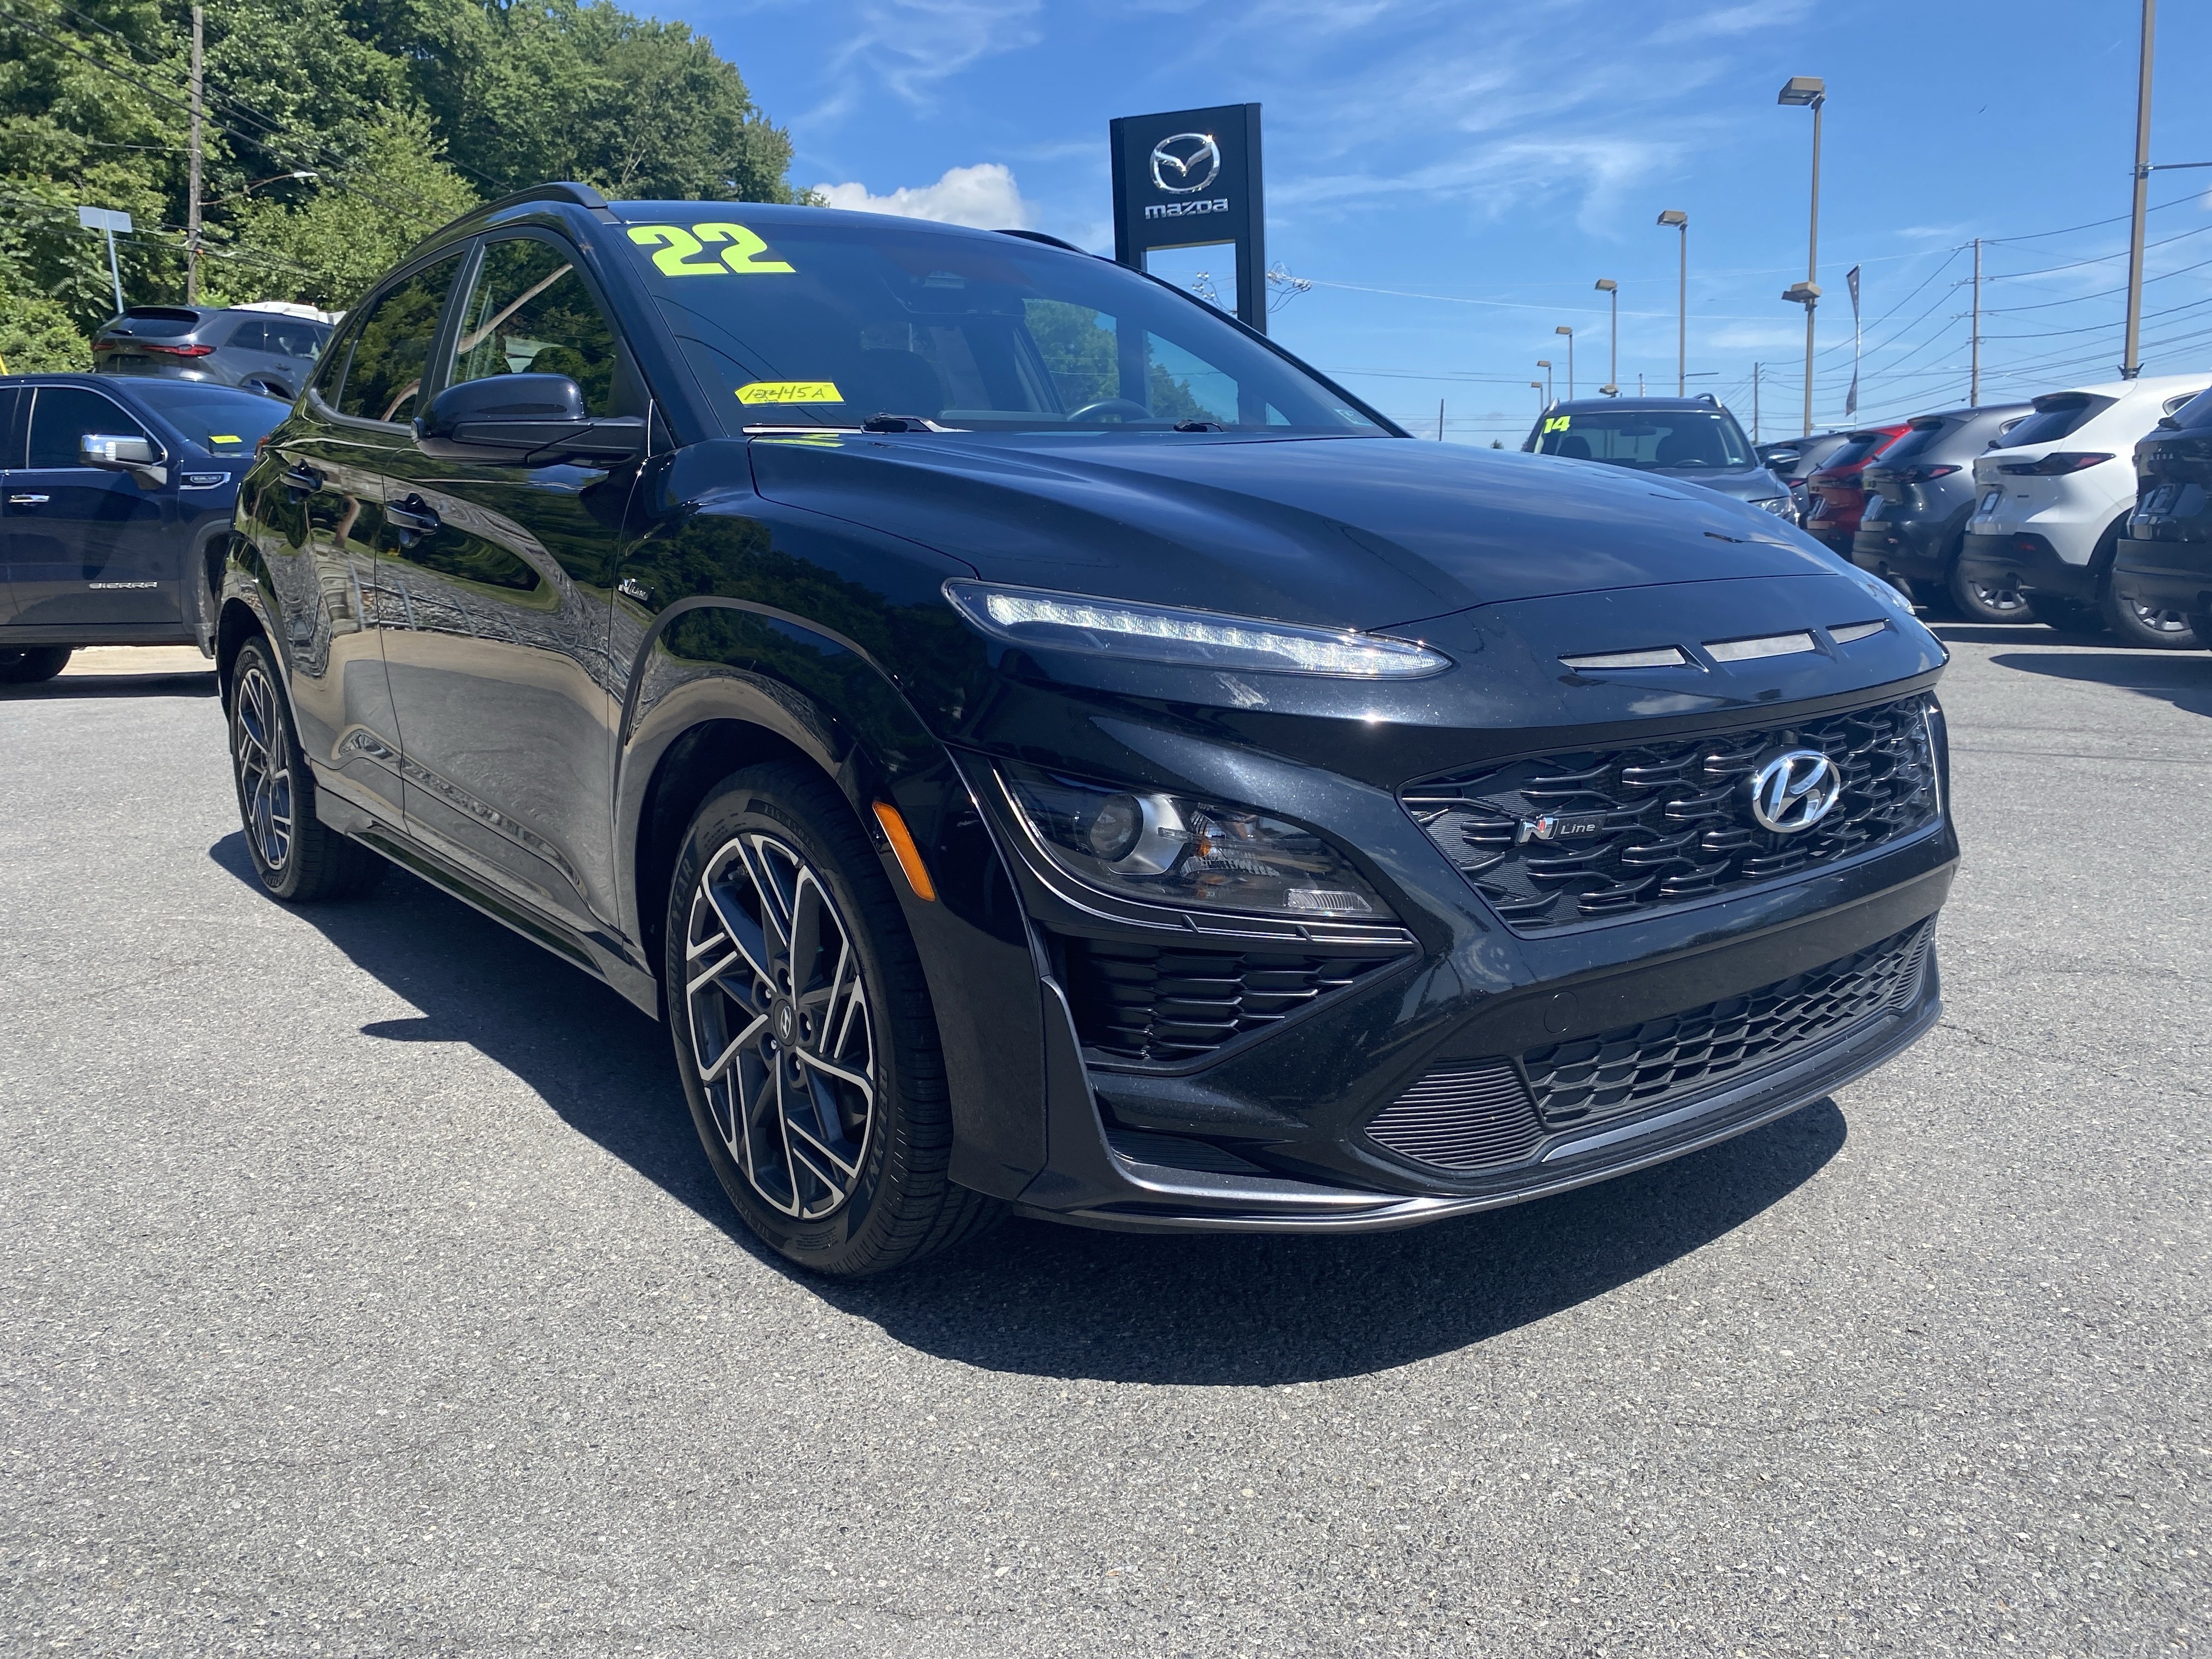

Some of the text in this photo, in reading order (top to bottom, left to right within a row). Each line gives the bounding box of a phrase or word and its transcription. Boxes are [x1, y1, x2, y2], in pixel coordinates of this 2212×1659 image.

[1145, 198, 1229, 219] mazda
[627, 223, 797, 276] 22
[1544, 415, 1571, 434] 14
[1515, 816, 1596, 844] N Line
[668, 857, 695, 1018] GOODYEAR
